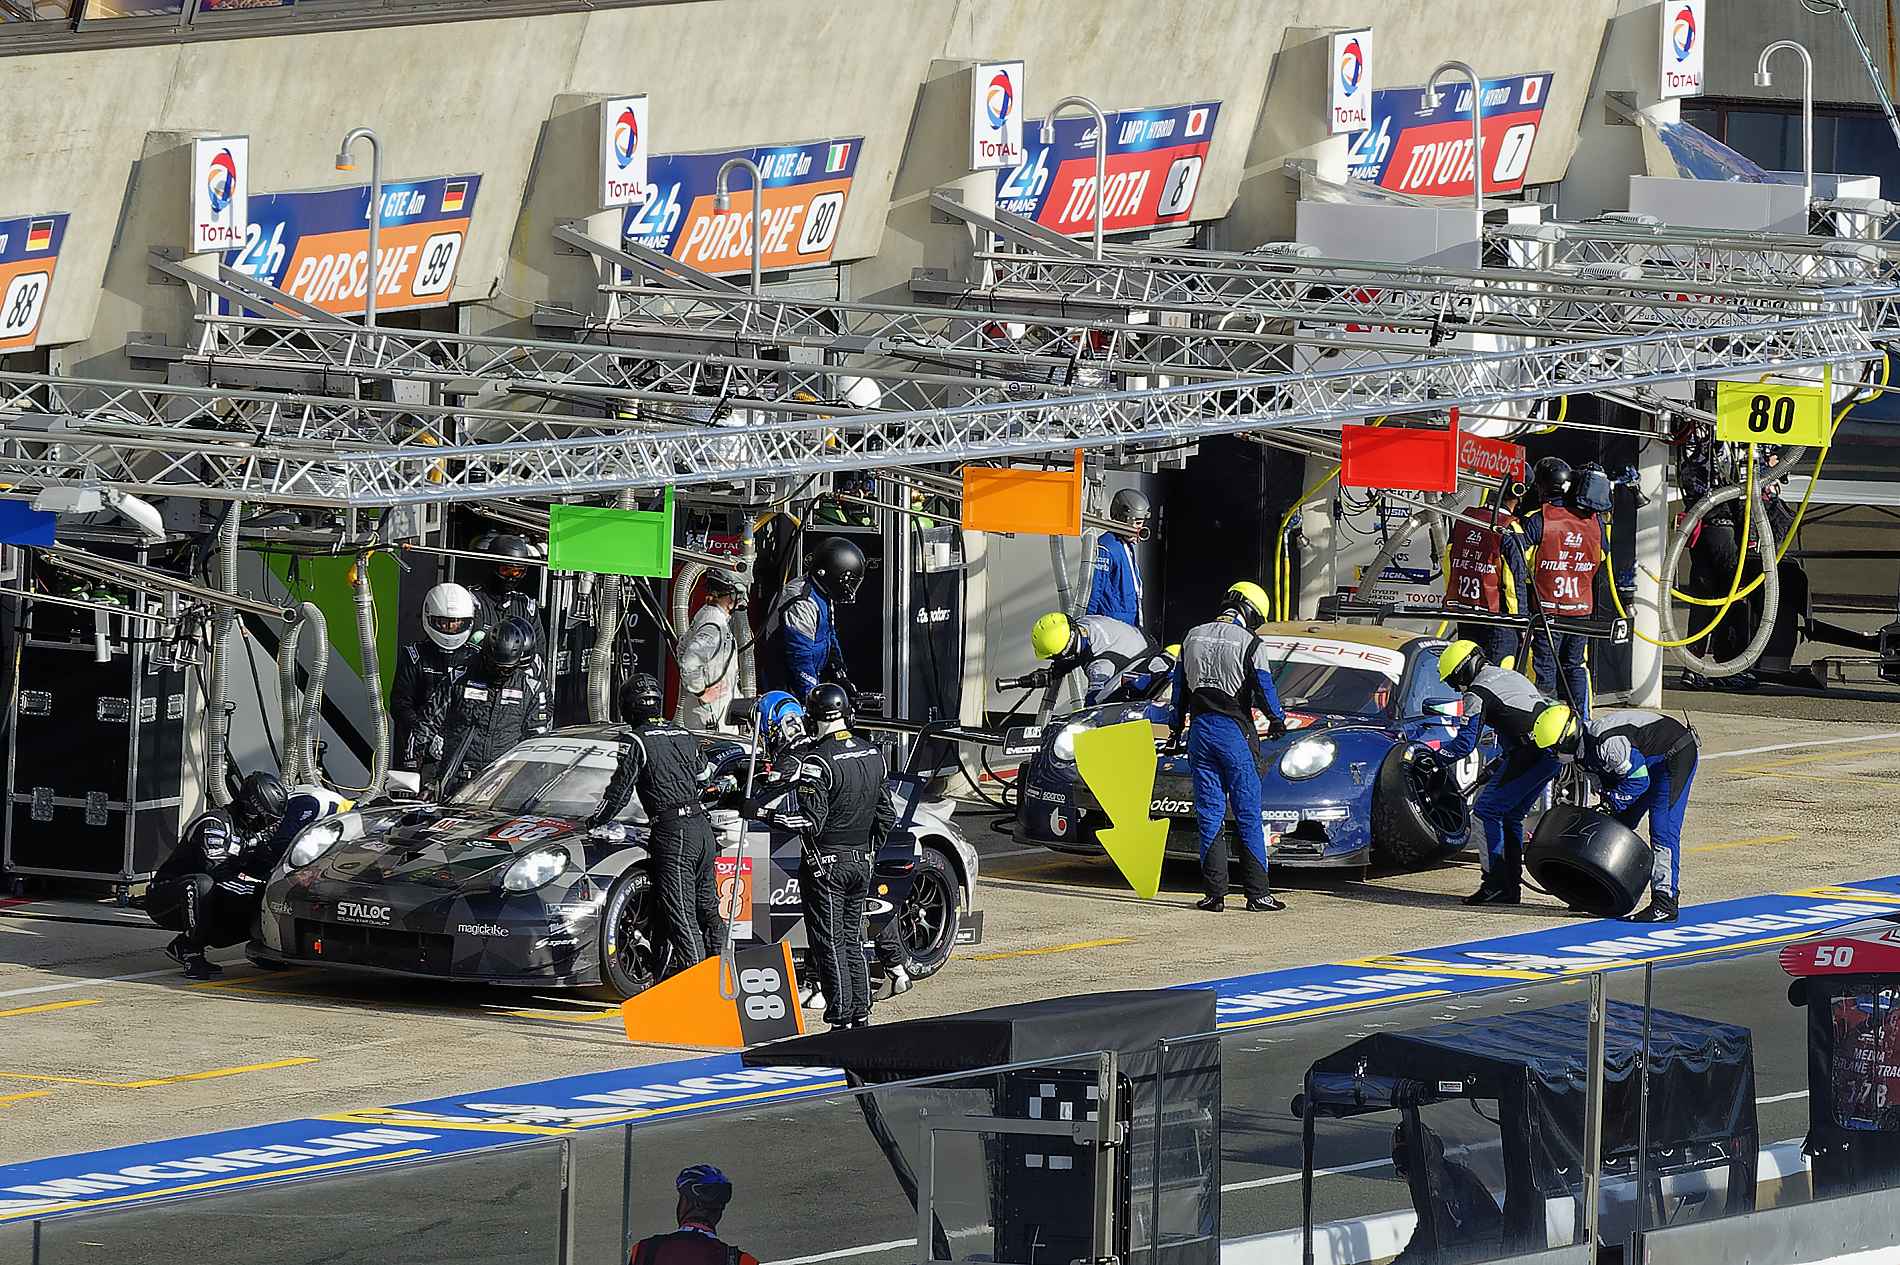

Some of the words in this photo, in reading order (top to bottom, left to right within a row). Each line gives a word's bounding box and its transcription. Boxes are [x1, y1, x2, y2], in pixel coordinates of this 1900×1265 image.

[1667, 72, 1699, 88] TOTAL
[1334, 107, 1366, 123] TOTAL
[1118, 119, 1148, 145] LMP1
[1147, 118, 1176, 139] HYBRID
[979, 140, 1018, 158] TOTAL
[1505, 133, 1524, 173] 7
[774, 152, 796, 178] GTE
[1400, 136, 1487, 190] TOYOTA
[608, 180, 643, 198] TOTAL
[1059, 169, 1151, 224] TOYOTA
[1171, 166, 1190, 207] 8
[384, 191, 411, 218] GTE
[1007, 198, 1038, 212] MANS
[200, 223, 242, 242] TOTAL
[679, 204, 804, 263] PORSCHE
[807, 200, 836, 244] 80
[289, 244, 418, 305] PORSCHE
[422, 241, 454, 287] 99
[6, 281, 39, 329] 88
[1748, 394, 1796, 434] 80
[1405, 593, 1444, 604] TOYOT
[1553, 576, 1580, 599] 341
[1265, 641, 1393, 667] RSCHE
[514, 744, 620, 759] PORSC
[1151, 797, 1193, 813] otors
[497, 822, 561, 841] 88
[337, 901, 391, 921] STALOC
[1557, 902, 1900, 957] MICHELIN
[1814, 945, 1855, 968] 50
[740, 967, 786, 1021] 88
[1216, 973, 1454, 1016] CHELIN
[571, 1065, 847, 1105] MICHE
[8, 1128, 442, 1198] MICHELIN
